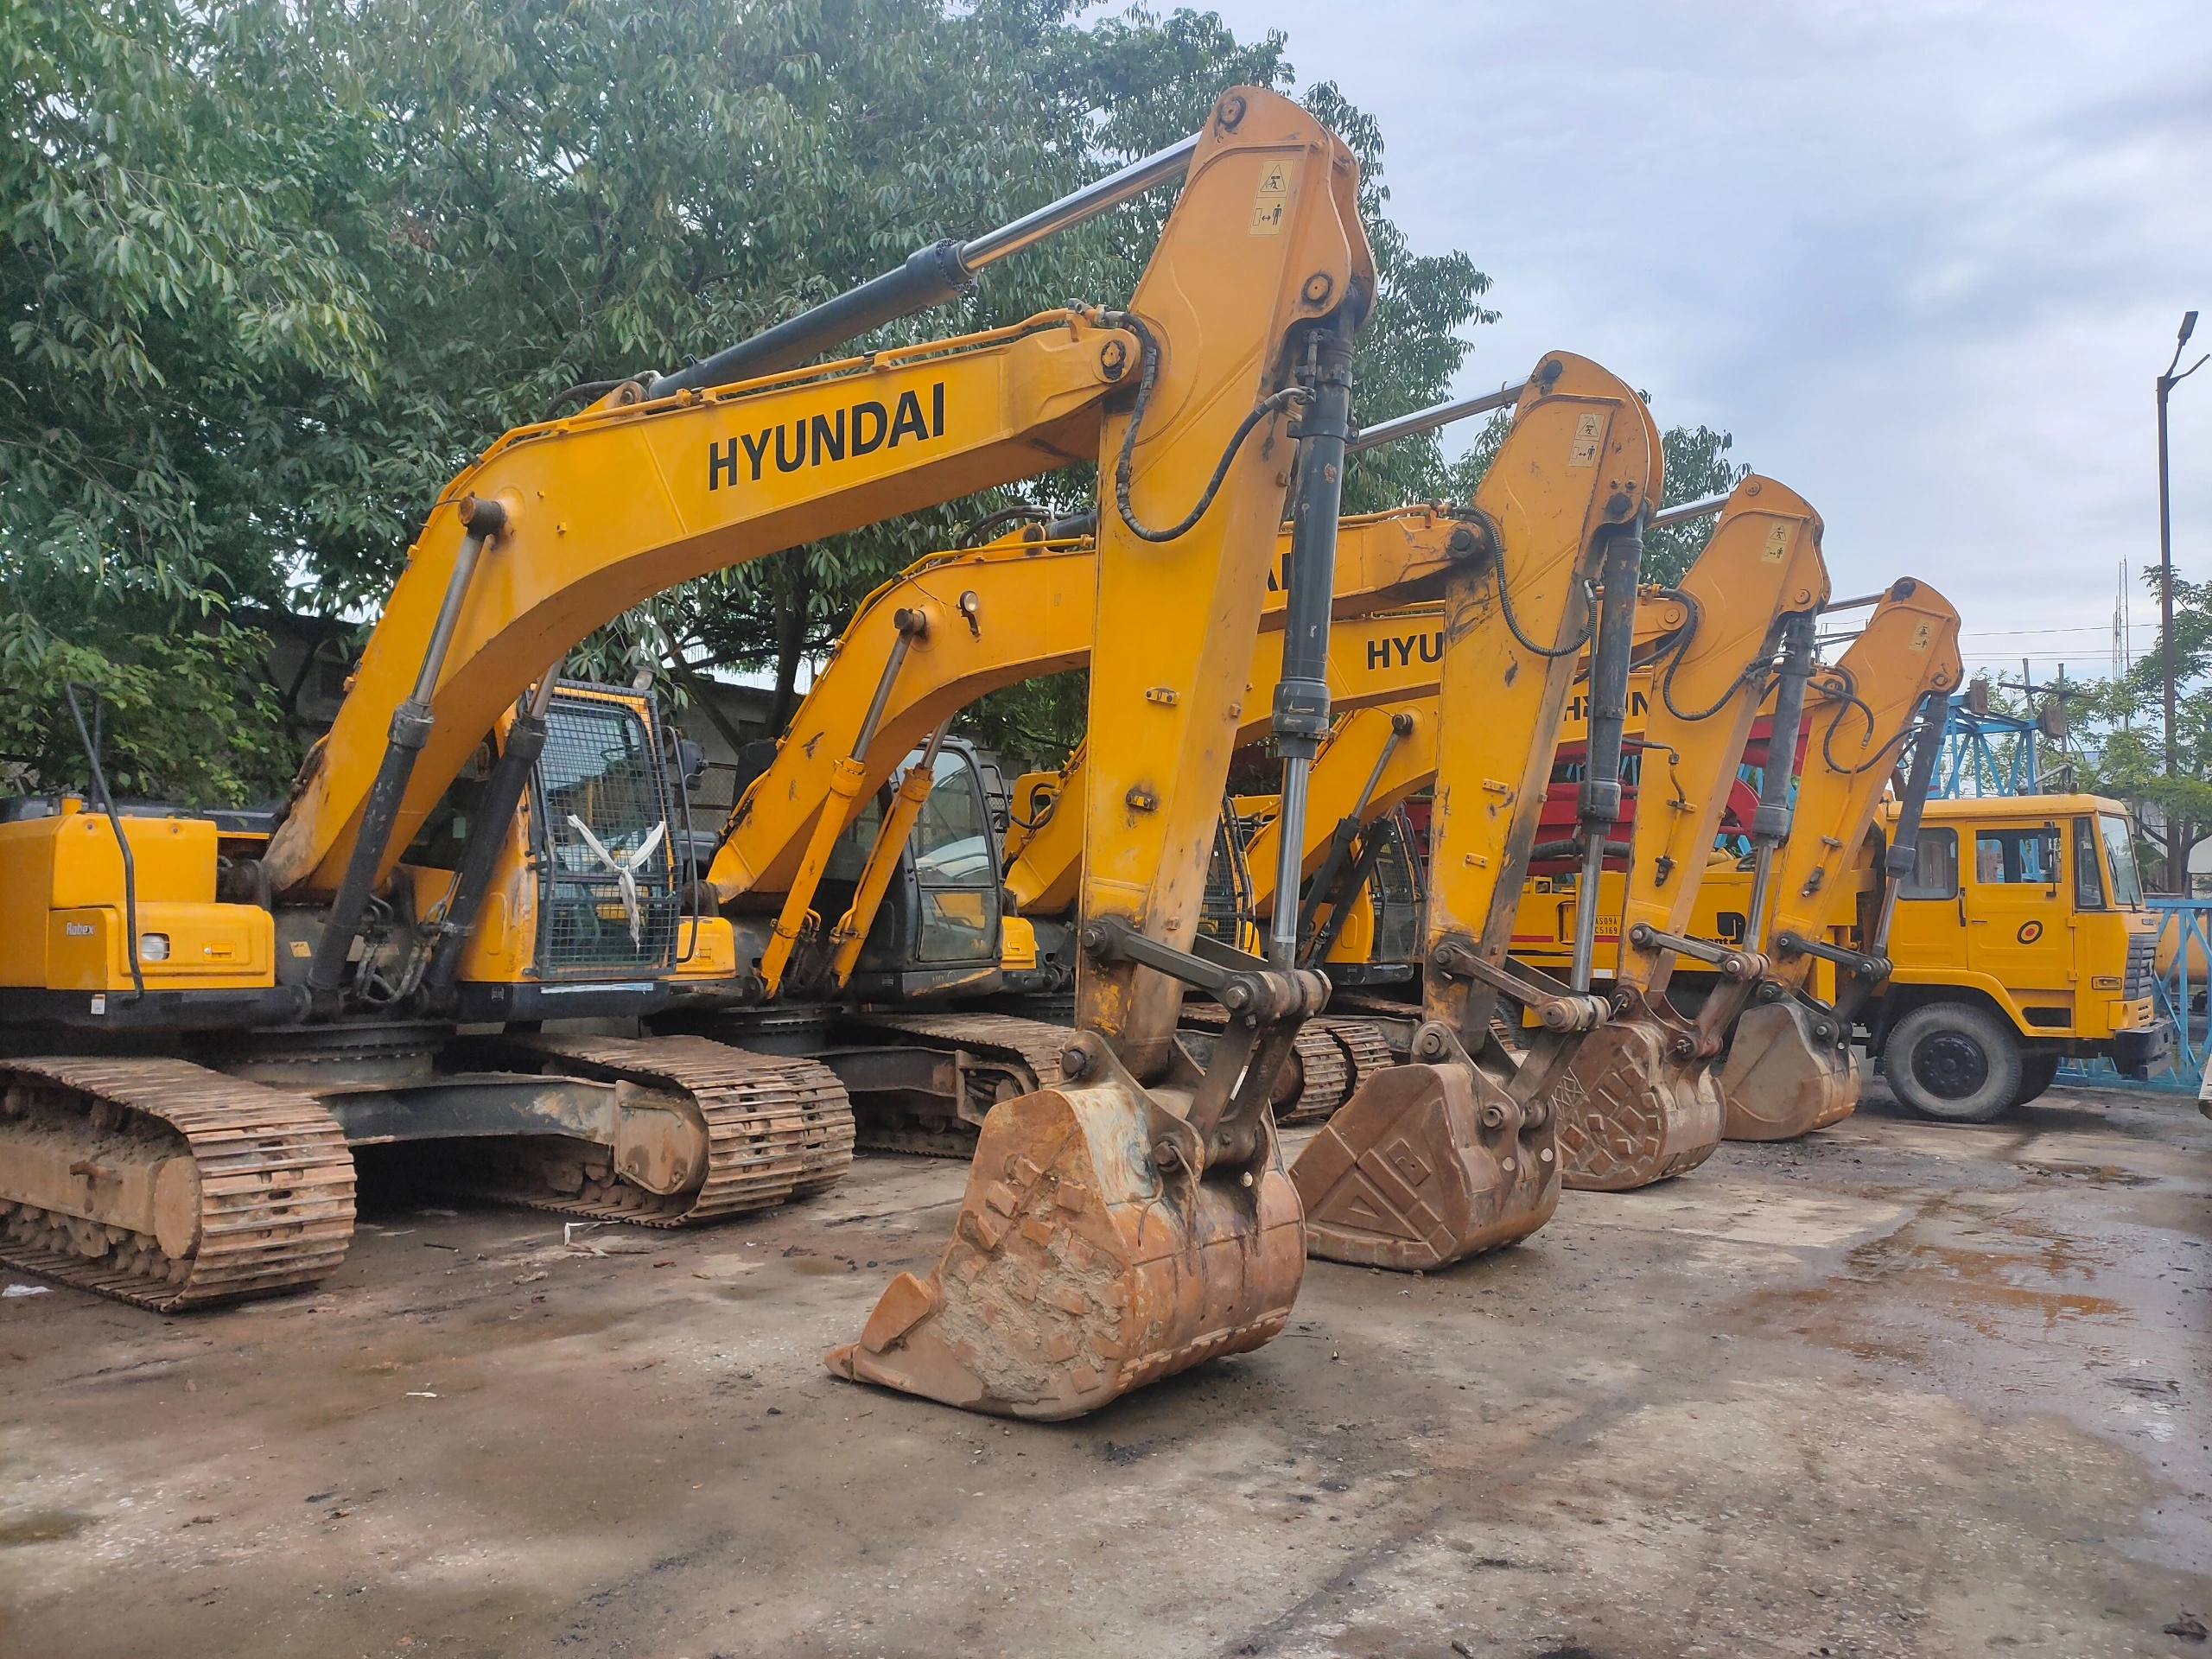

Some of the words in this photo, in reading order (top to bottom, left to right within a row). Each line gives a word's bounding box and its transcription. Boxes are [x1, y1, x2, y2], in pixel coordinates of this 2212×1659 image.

[709, 381, 944, 492] HYUNDAI
[1367, 632, 1443, 670] HYU
[66, 921, 94, 936] Robex
[1594, 926, 1618, 935] C5169
